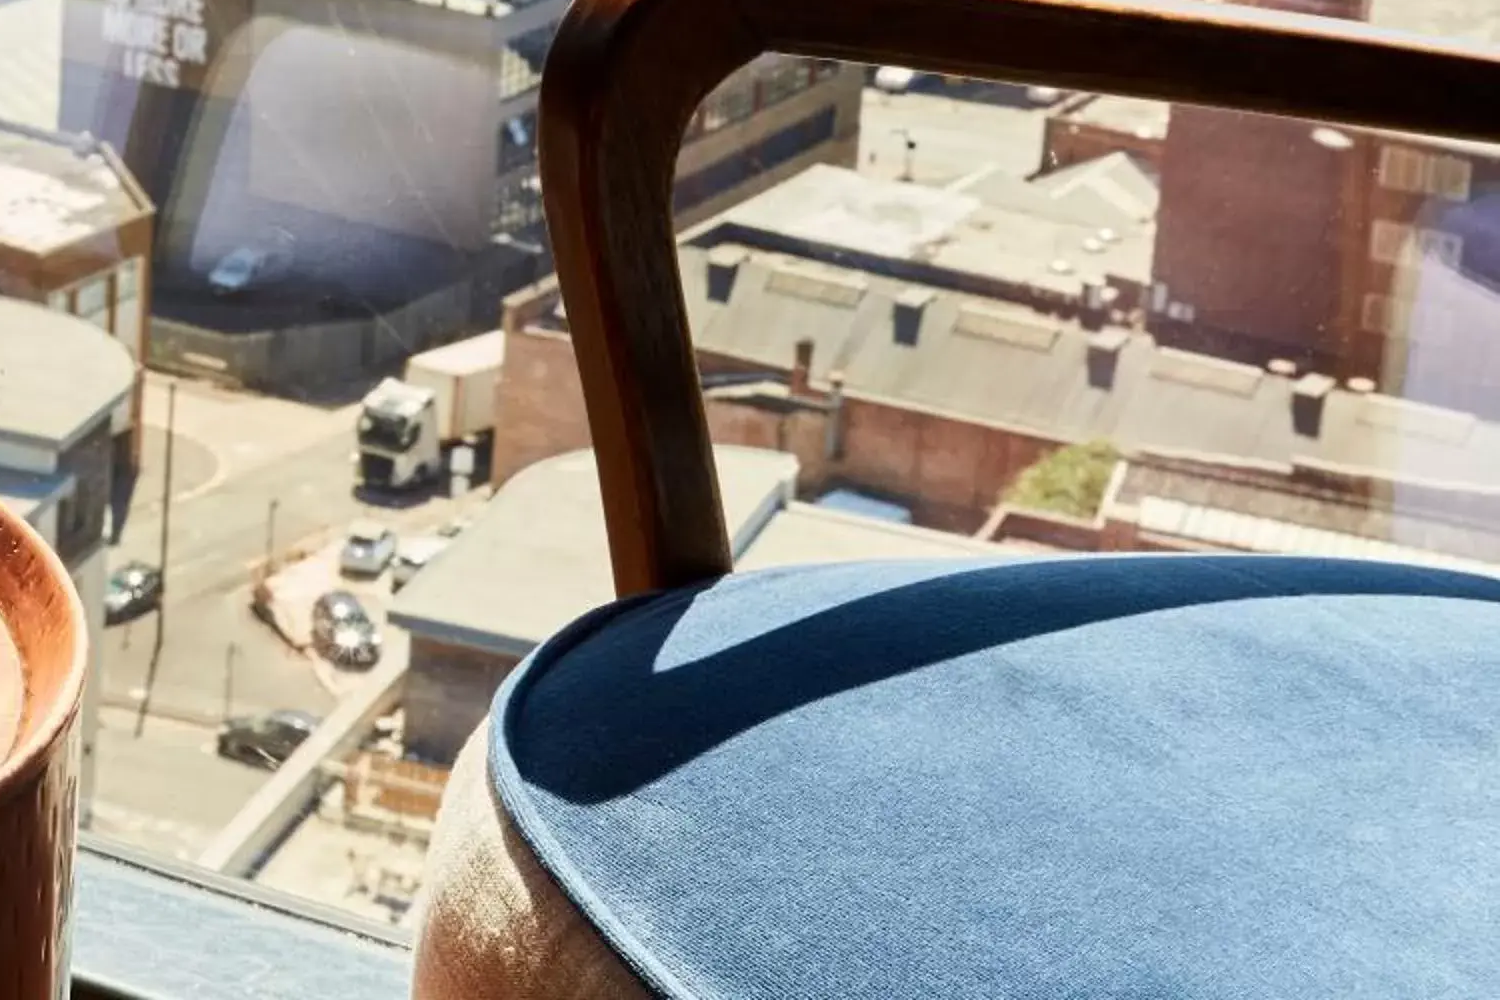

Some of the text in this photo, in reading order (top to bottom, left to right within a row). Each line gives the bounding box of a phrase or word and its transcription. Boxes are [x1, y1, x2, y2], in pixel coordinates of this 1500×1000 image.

[102, 4, 207, 65] MORE OR
[123, 48, 181, 89] LESS
